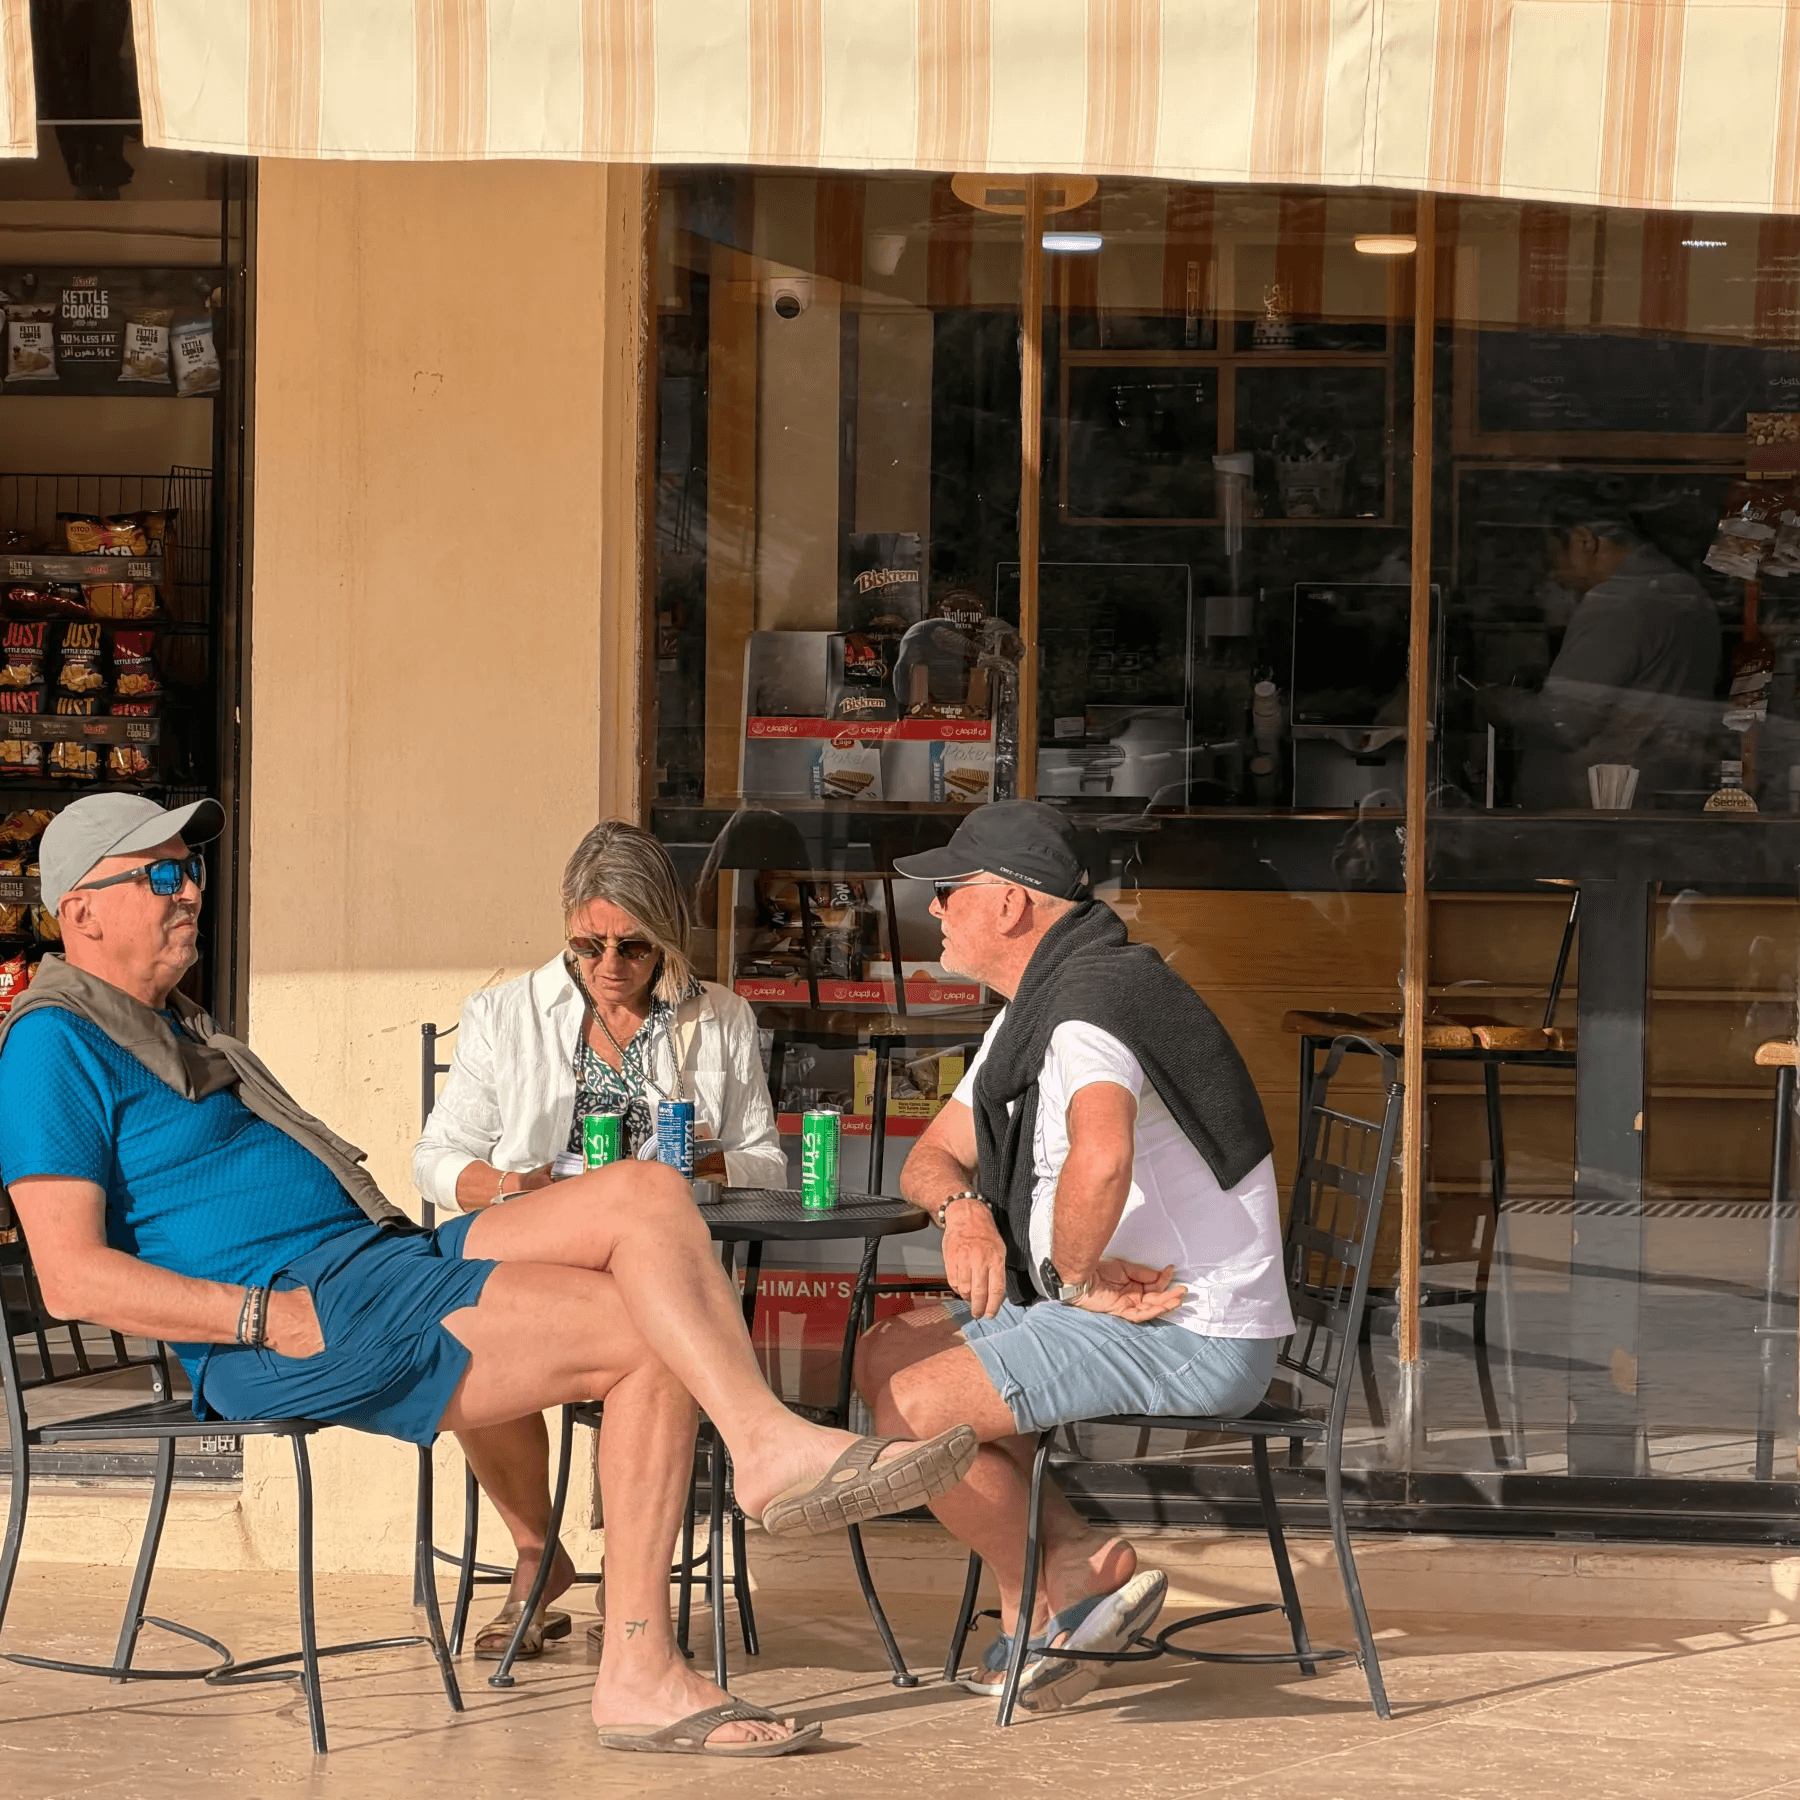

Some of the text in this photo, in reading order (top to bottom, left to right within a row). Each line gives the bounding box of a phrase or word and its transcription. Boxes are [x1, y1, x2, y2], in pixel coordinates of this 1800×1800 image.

[62, 290, 108, 304] KETTLE
[62, 304, 109, 319] COOKED
[60, 334, 116, 344] 40% LESS FAT
[9, 561, 33, 569] KETTLE
[128, 562, 152, 570] KETTLE
[853, 568, 919, 594] Biskrem
[3, 622, 47, 647] JUST
[62, 622, 101, 649] JUST
[22, 647, 43, 655] COOKED
[838, 697, 886, 713] Biskrem
[127, 722, 151, 730] KETTLE
[943, 744, 989, 763] Poker
[933, 762, 942, 802] GAR FREE
[1713, 797, 1748, 807] Secret
[680, 1120, 694, 1172] kinza
